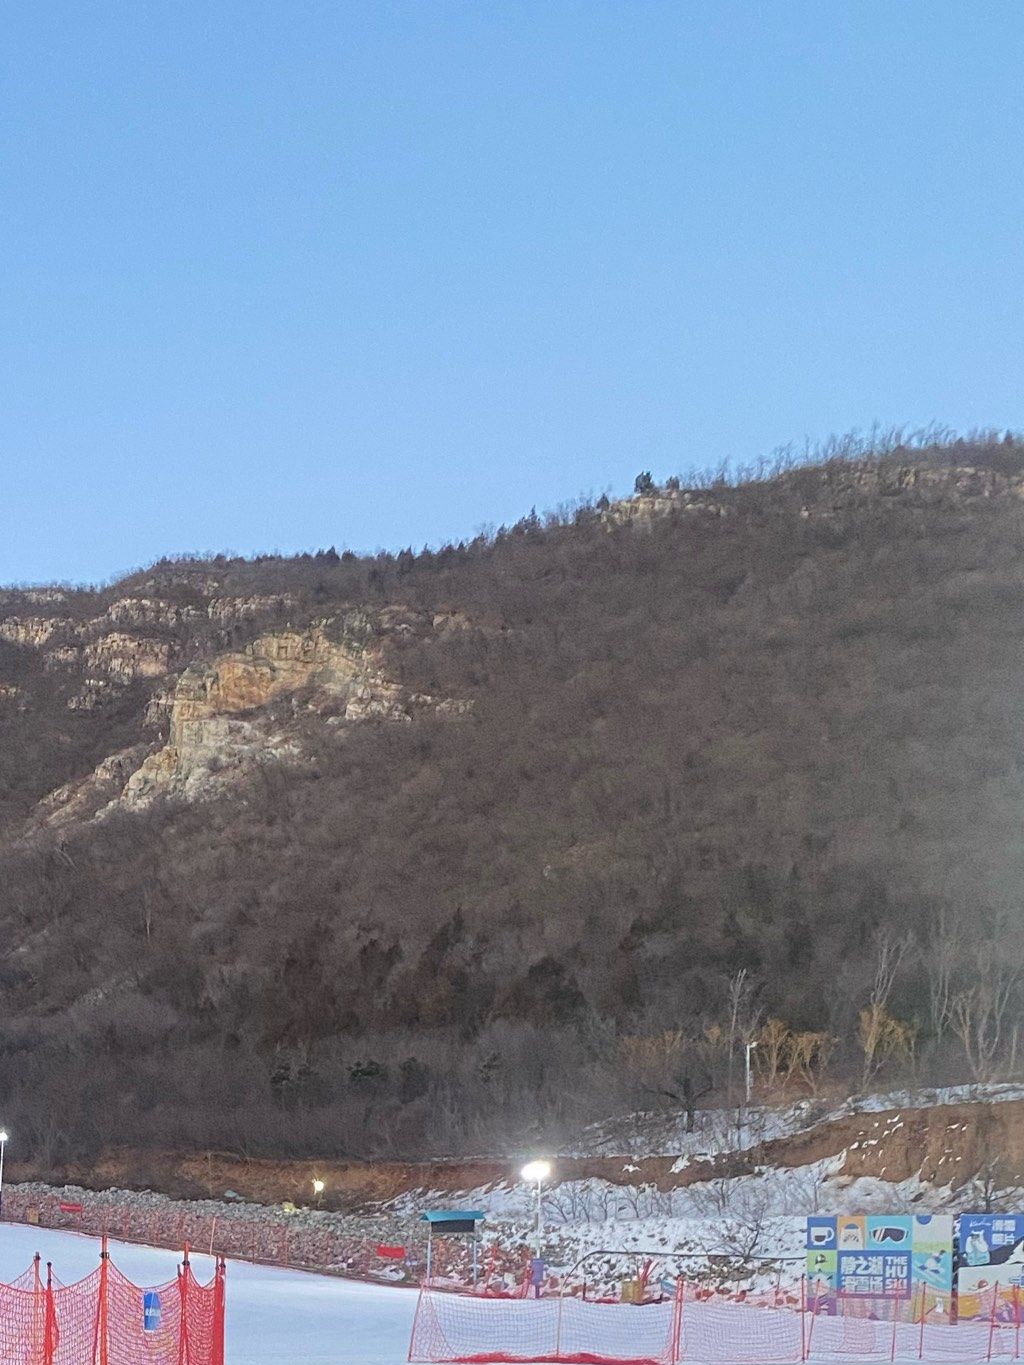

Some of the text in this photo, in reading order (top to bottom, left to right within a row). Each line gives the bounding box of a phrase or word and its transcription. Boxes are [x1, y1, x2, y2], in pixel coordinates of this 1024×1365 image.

[840, 1256, 883, 1275] 静之湖
[885, 1256, 908, 1265] THE
[885, 1265, 908, 1278] HU
[885, 1278, 908, 1289] SKI
